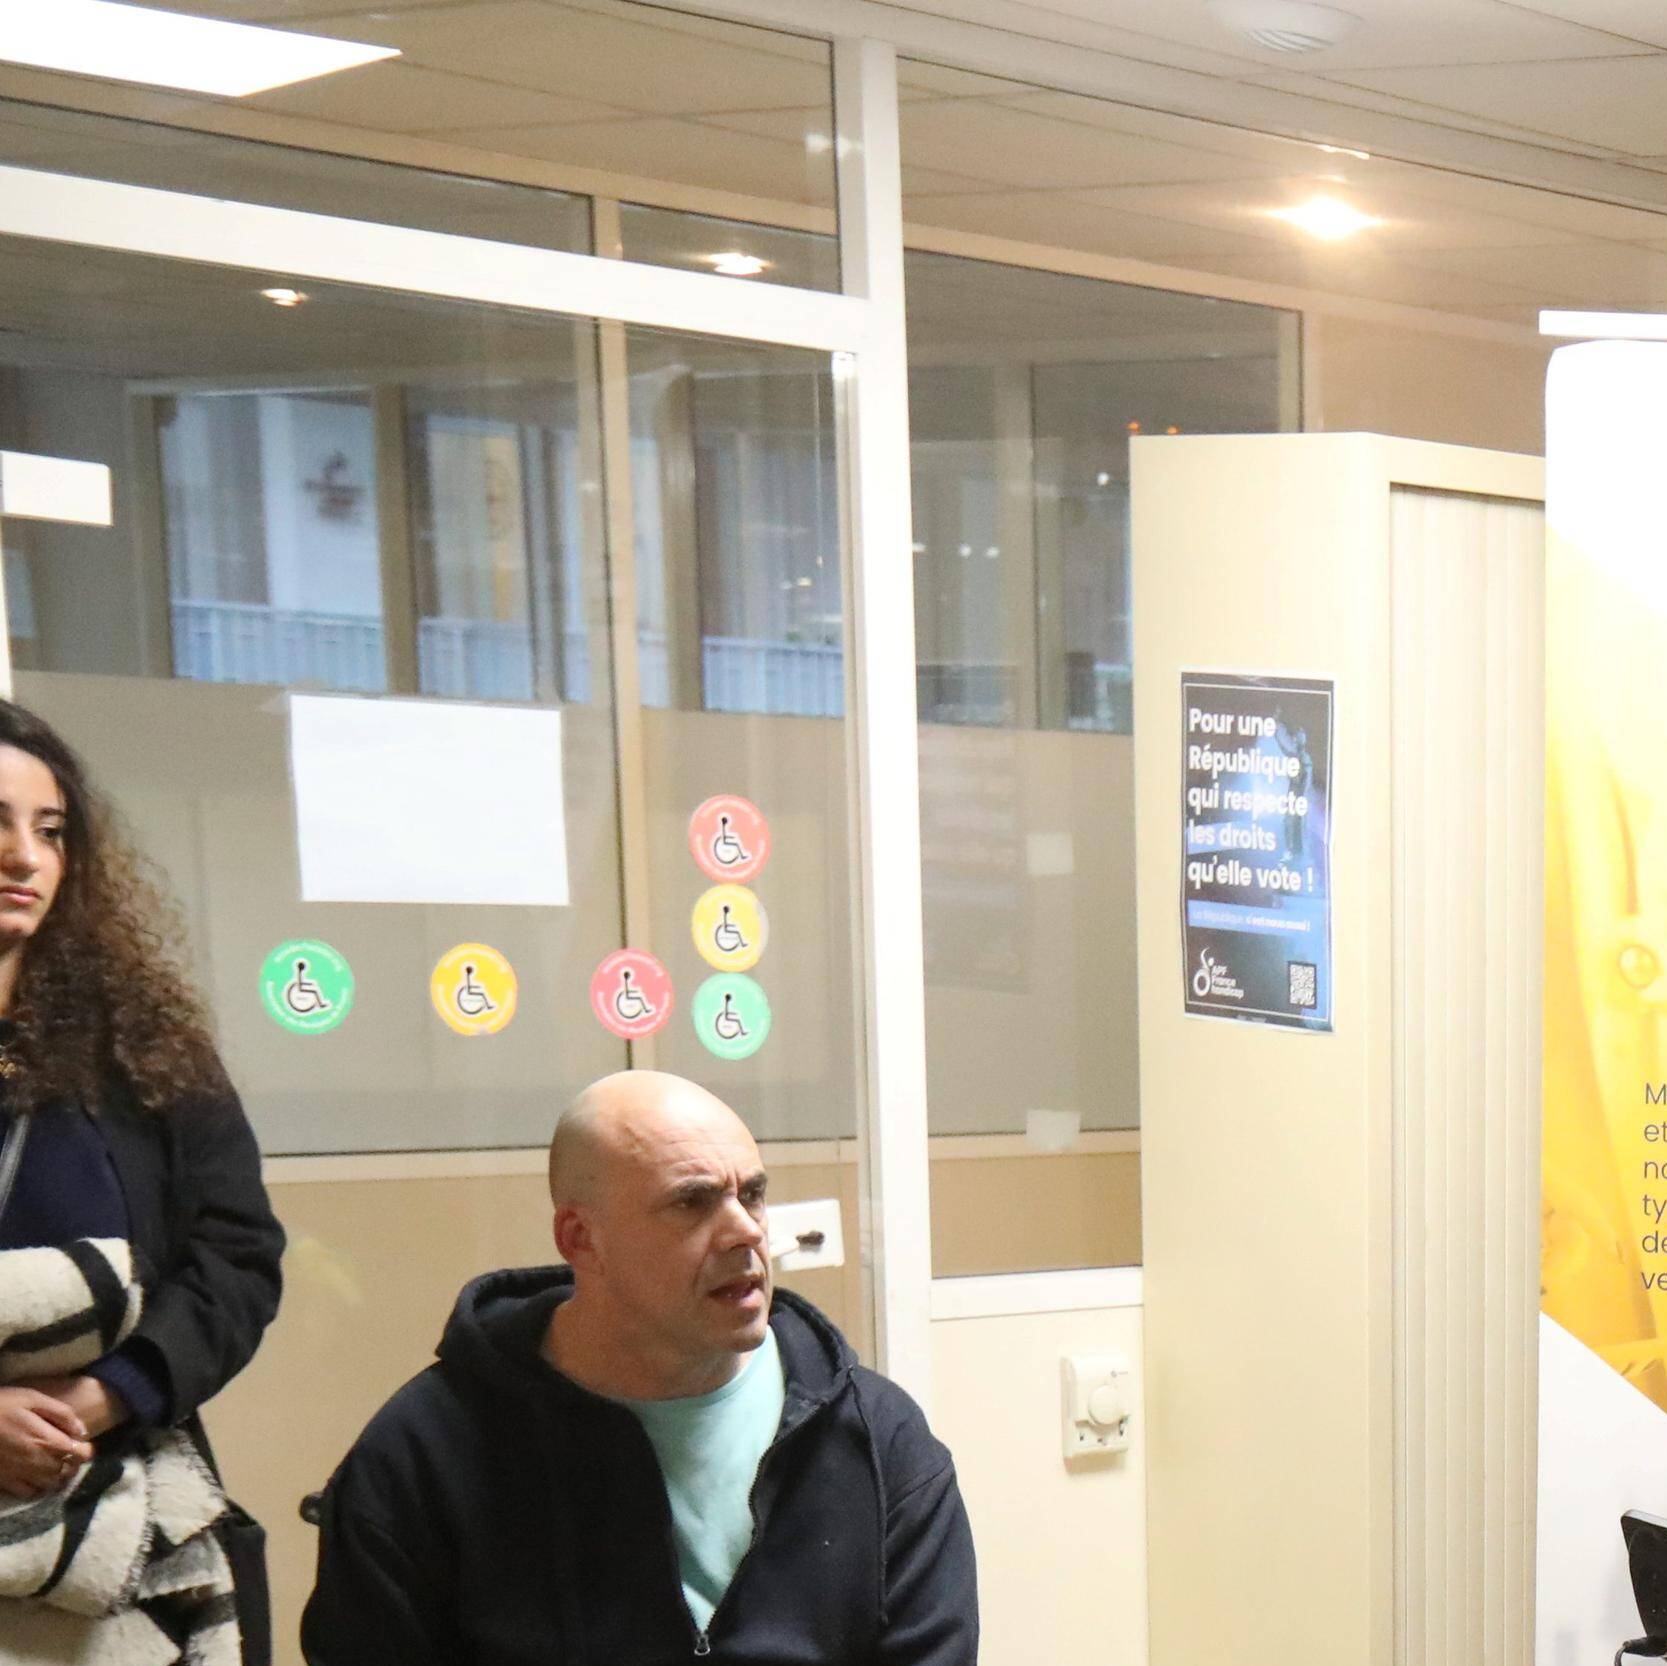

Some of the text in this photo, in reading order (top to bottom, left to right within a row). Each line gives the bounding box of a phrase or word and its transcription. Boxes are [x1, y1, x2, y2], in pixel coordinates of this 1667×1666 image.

[1189, 708, 1276, 737] Pour une
[1188, 744, 1301, 784] République
[1188, 783, 1308, 819] qui respecte
[1189, 819, 1276, 851] les droits
[1188, 855, 1313, 892] qu'elle vote !
